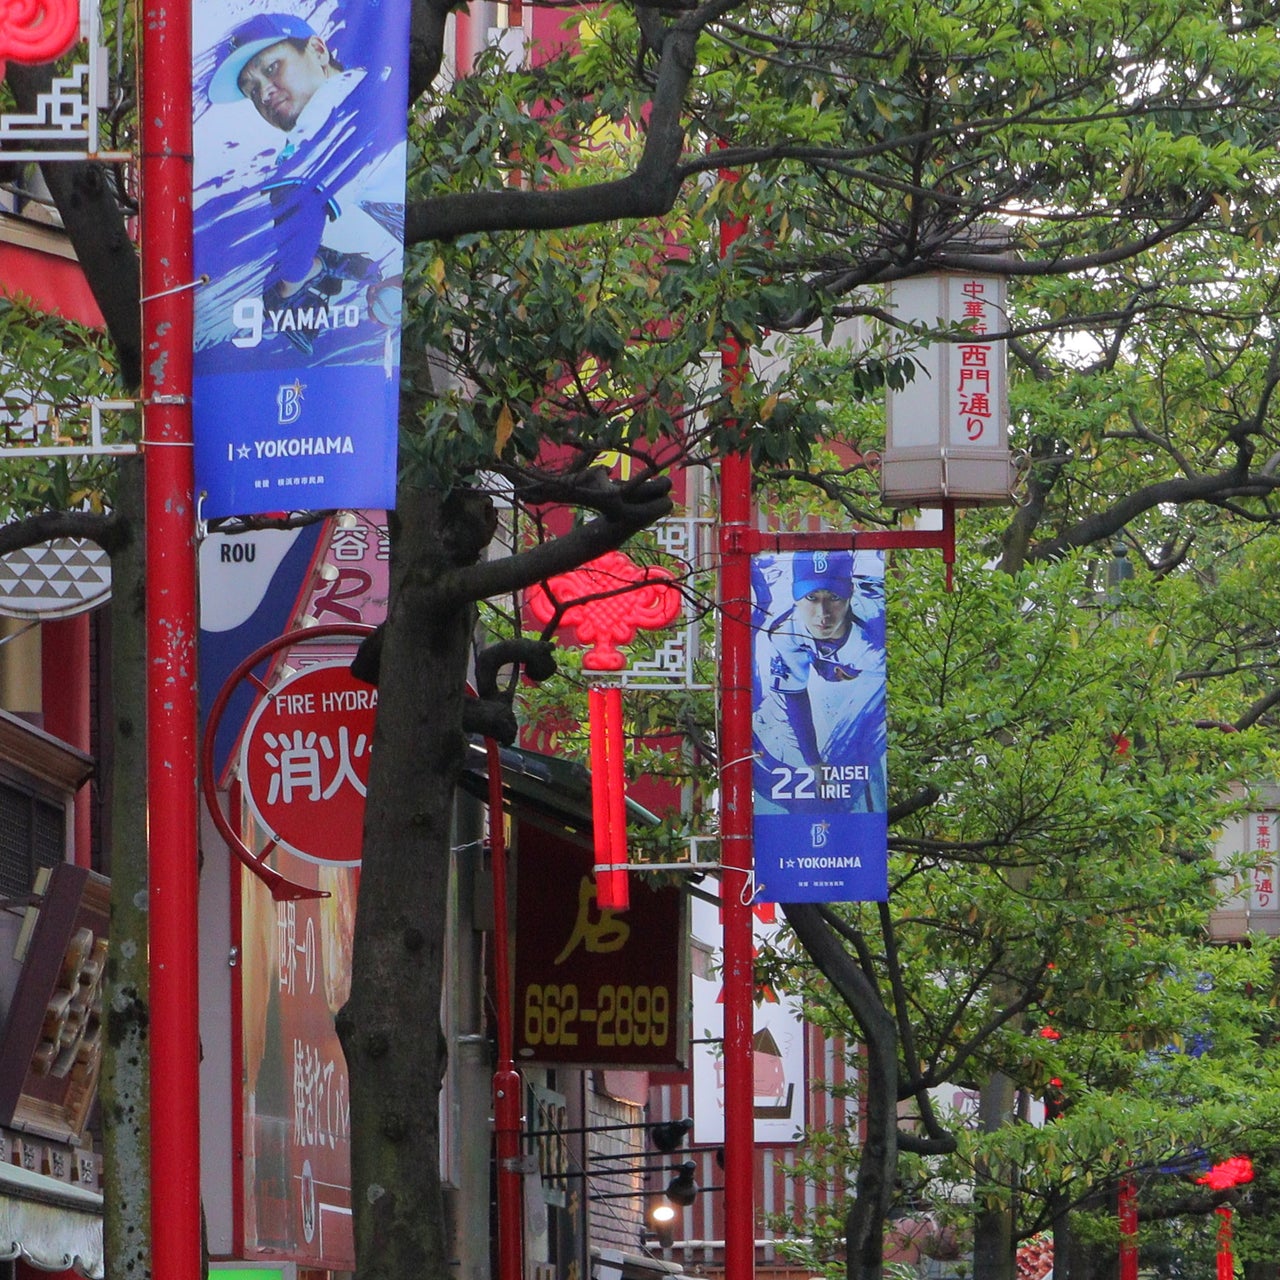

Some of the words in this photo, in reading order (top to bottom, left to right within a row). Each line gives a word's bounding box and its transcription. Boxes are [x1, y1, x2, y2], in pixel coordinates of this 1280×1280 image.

[231, 297, 264, 348] 9
[268, 303, 361, 333] YAMATO
[254, 435, 354, 459] YOKOHAMA
[220, 543, 256, 563] ROU
[275, 693, 316, 716] FIRE
[263, 725, 373, 805] 消火
[771, 767, 816, 800] 22
[820, 765, 869, 781] TAISEI
[820, 784, 851, 799] IRIE
[796, 856, 862, 869] YOKOHAMA
[524, 983, 669, 1047] 662-2899
